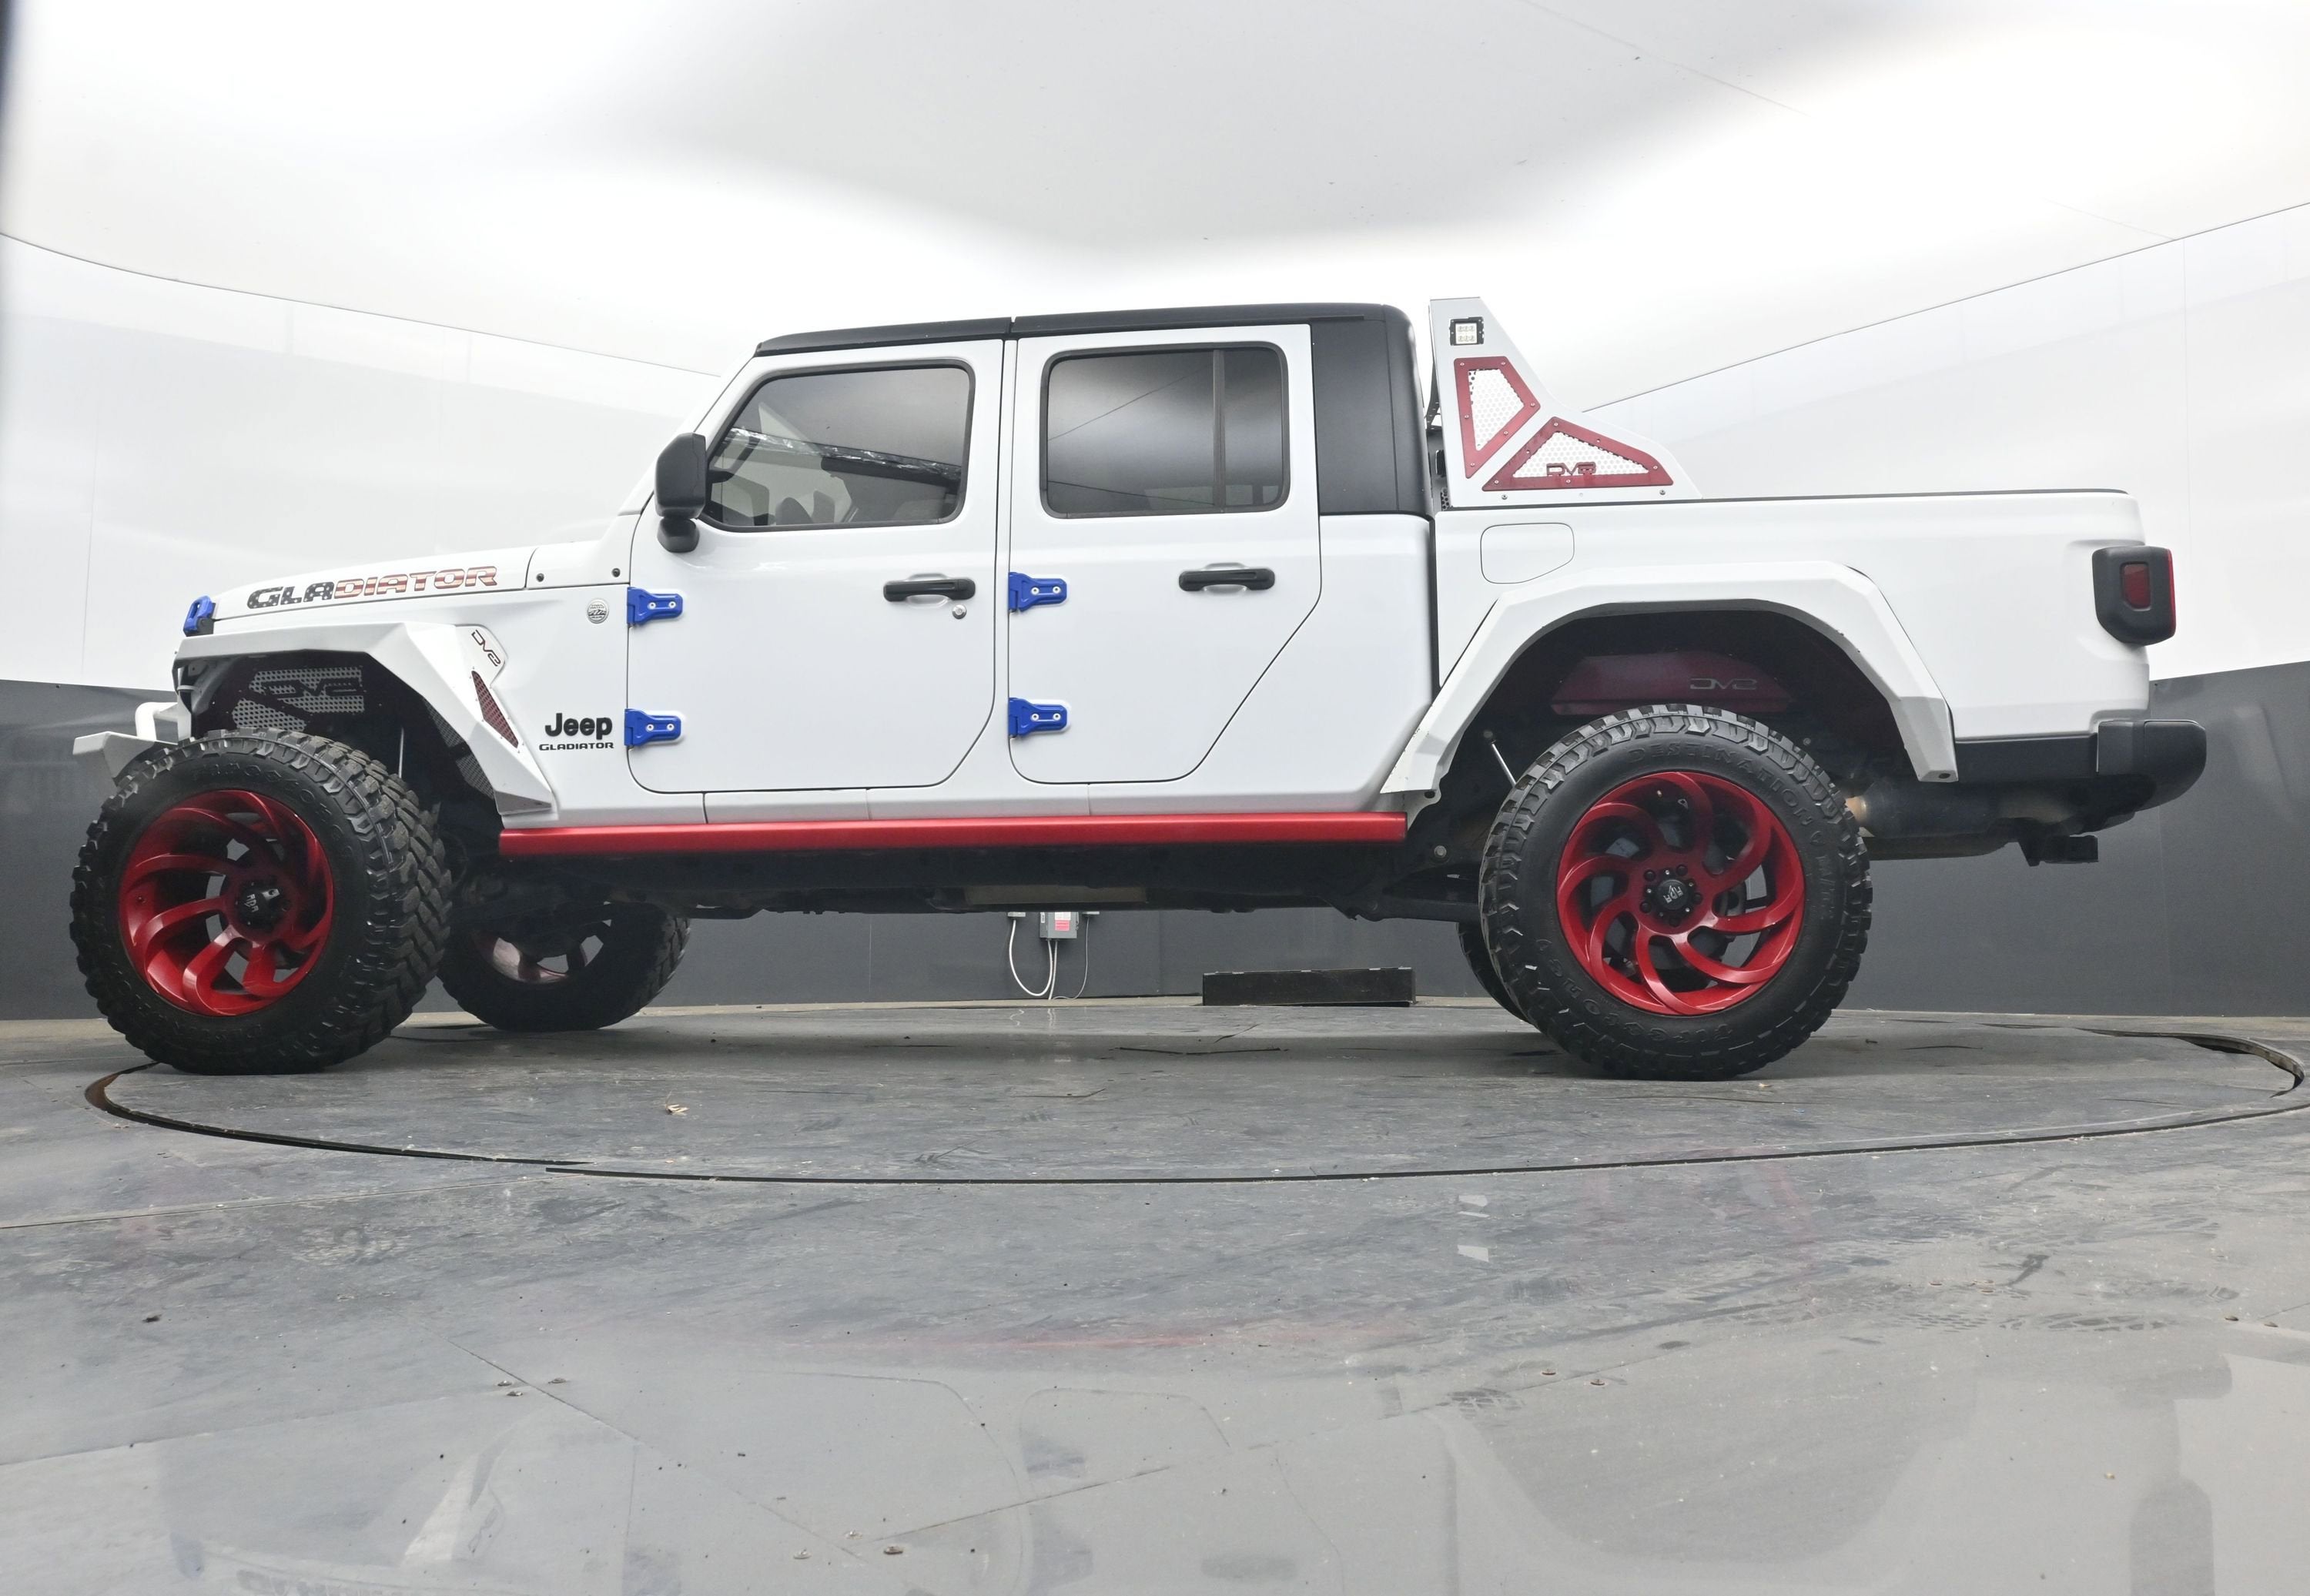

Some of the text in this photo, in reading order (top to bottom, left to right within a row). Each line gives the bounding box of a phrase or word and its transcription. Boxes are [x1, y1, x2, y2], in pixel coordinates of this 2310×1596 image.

[246, 565, 497, 610] GLADIATOR
[544, 712, 613, 741] Jeep
[538, 741, 614, 751] GLADIATOR
